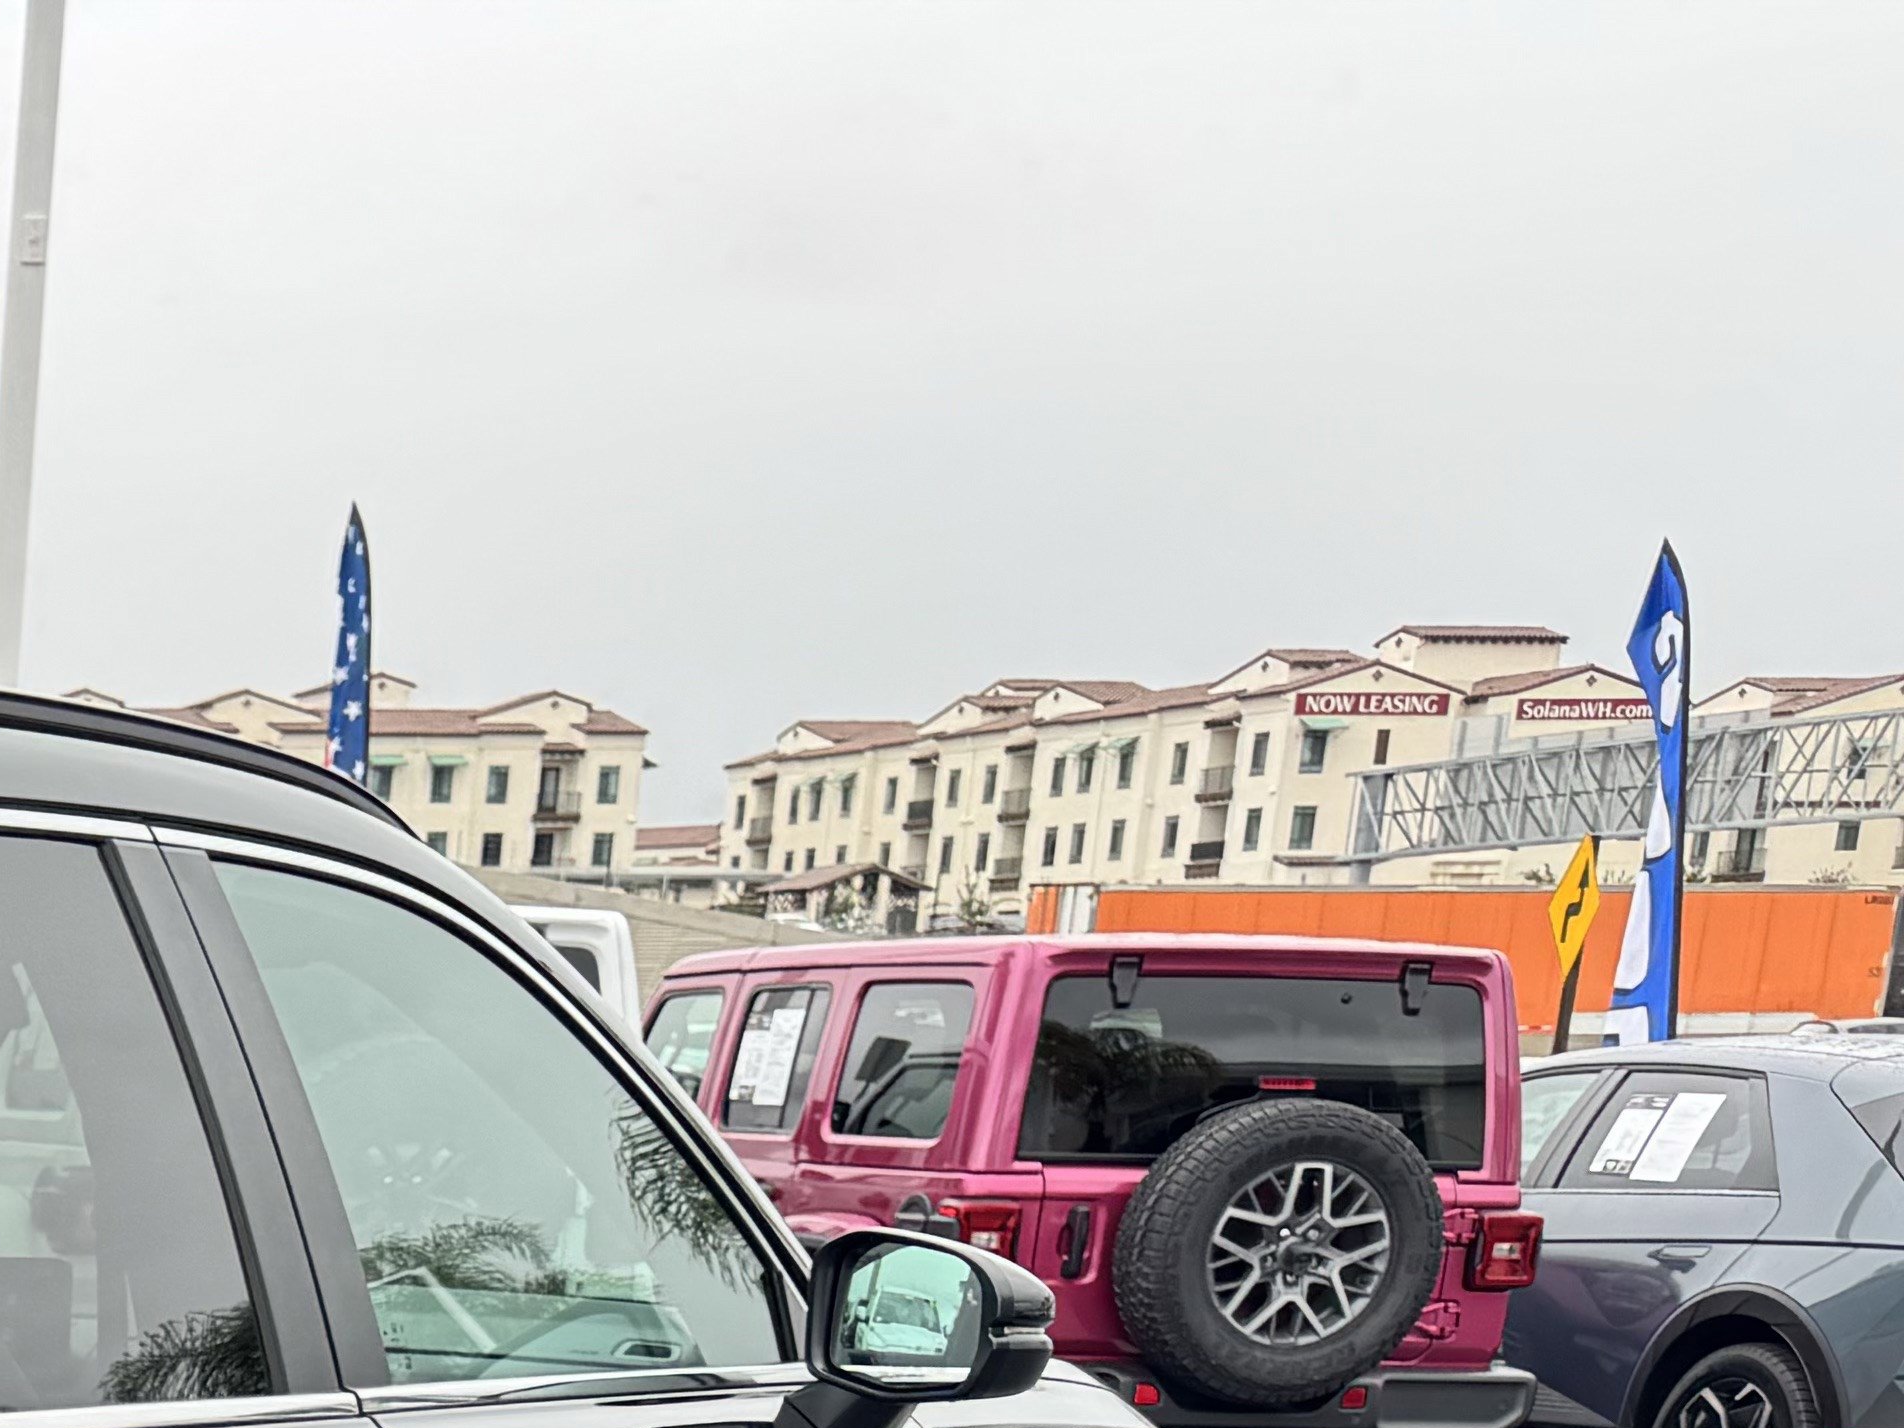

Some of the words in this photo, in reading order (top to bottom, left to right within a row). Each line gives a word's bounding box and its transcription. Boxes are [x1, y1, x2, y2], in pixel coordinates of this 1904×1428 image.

[1305, 694, 1355, 714] NOW
[1357, 694, 1440, 715] LEASING
[1520, 701, 1653, 721] SolanaWH.com
